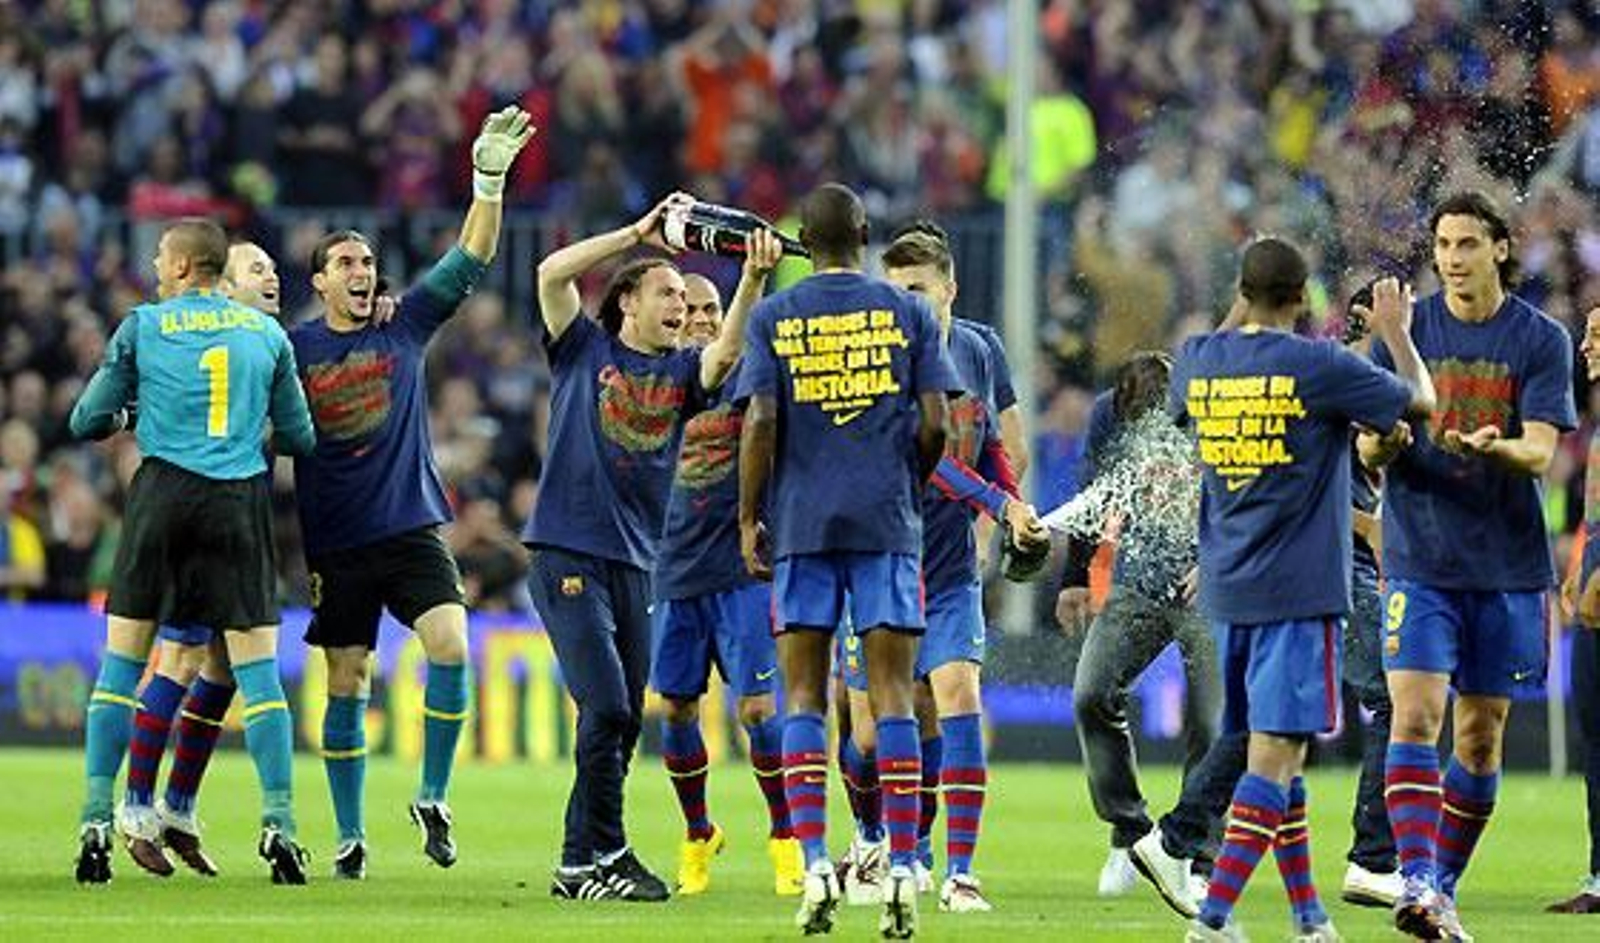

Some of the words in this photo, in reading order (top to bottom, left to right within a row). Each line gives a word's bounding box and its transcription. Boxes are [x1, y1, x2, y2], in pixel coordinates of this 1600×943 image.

[776, 318, 804, 338] NO
[870, 310, 895, 329] EN
[847, 350, 869, 369] EN
[871, 346, 892, 366] LA
[199, 344, 229, 438] 1
[1270, 376, 1295, 397] EN
[1264, 418, 1286, 434] LA
[1387, 592, 1406, 630] 9
